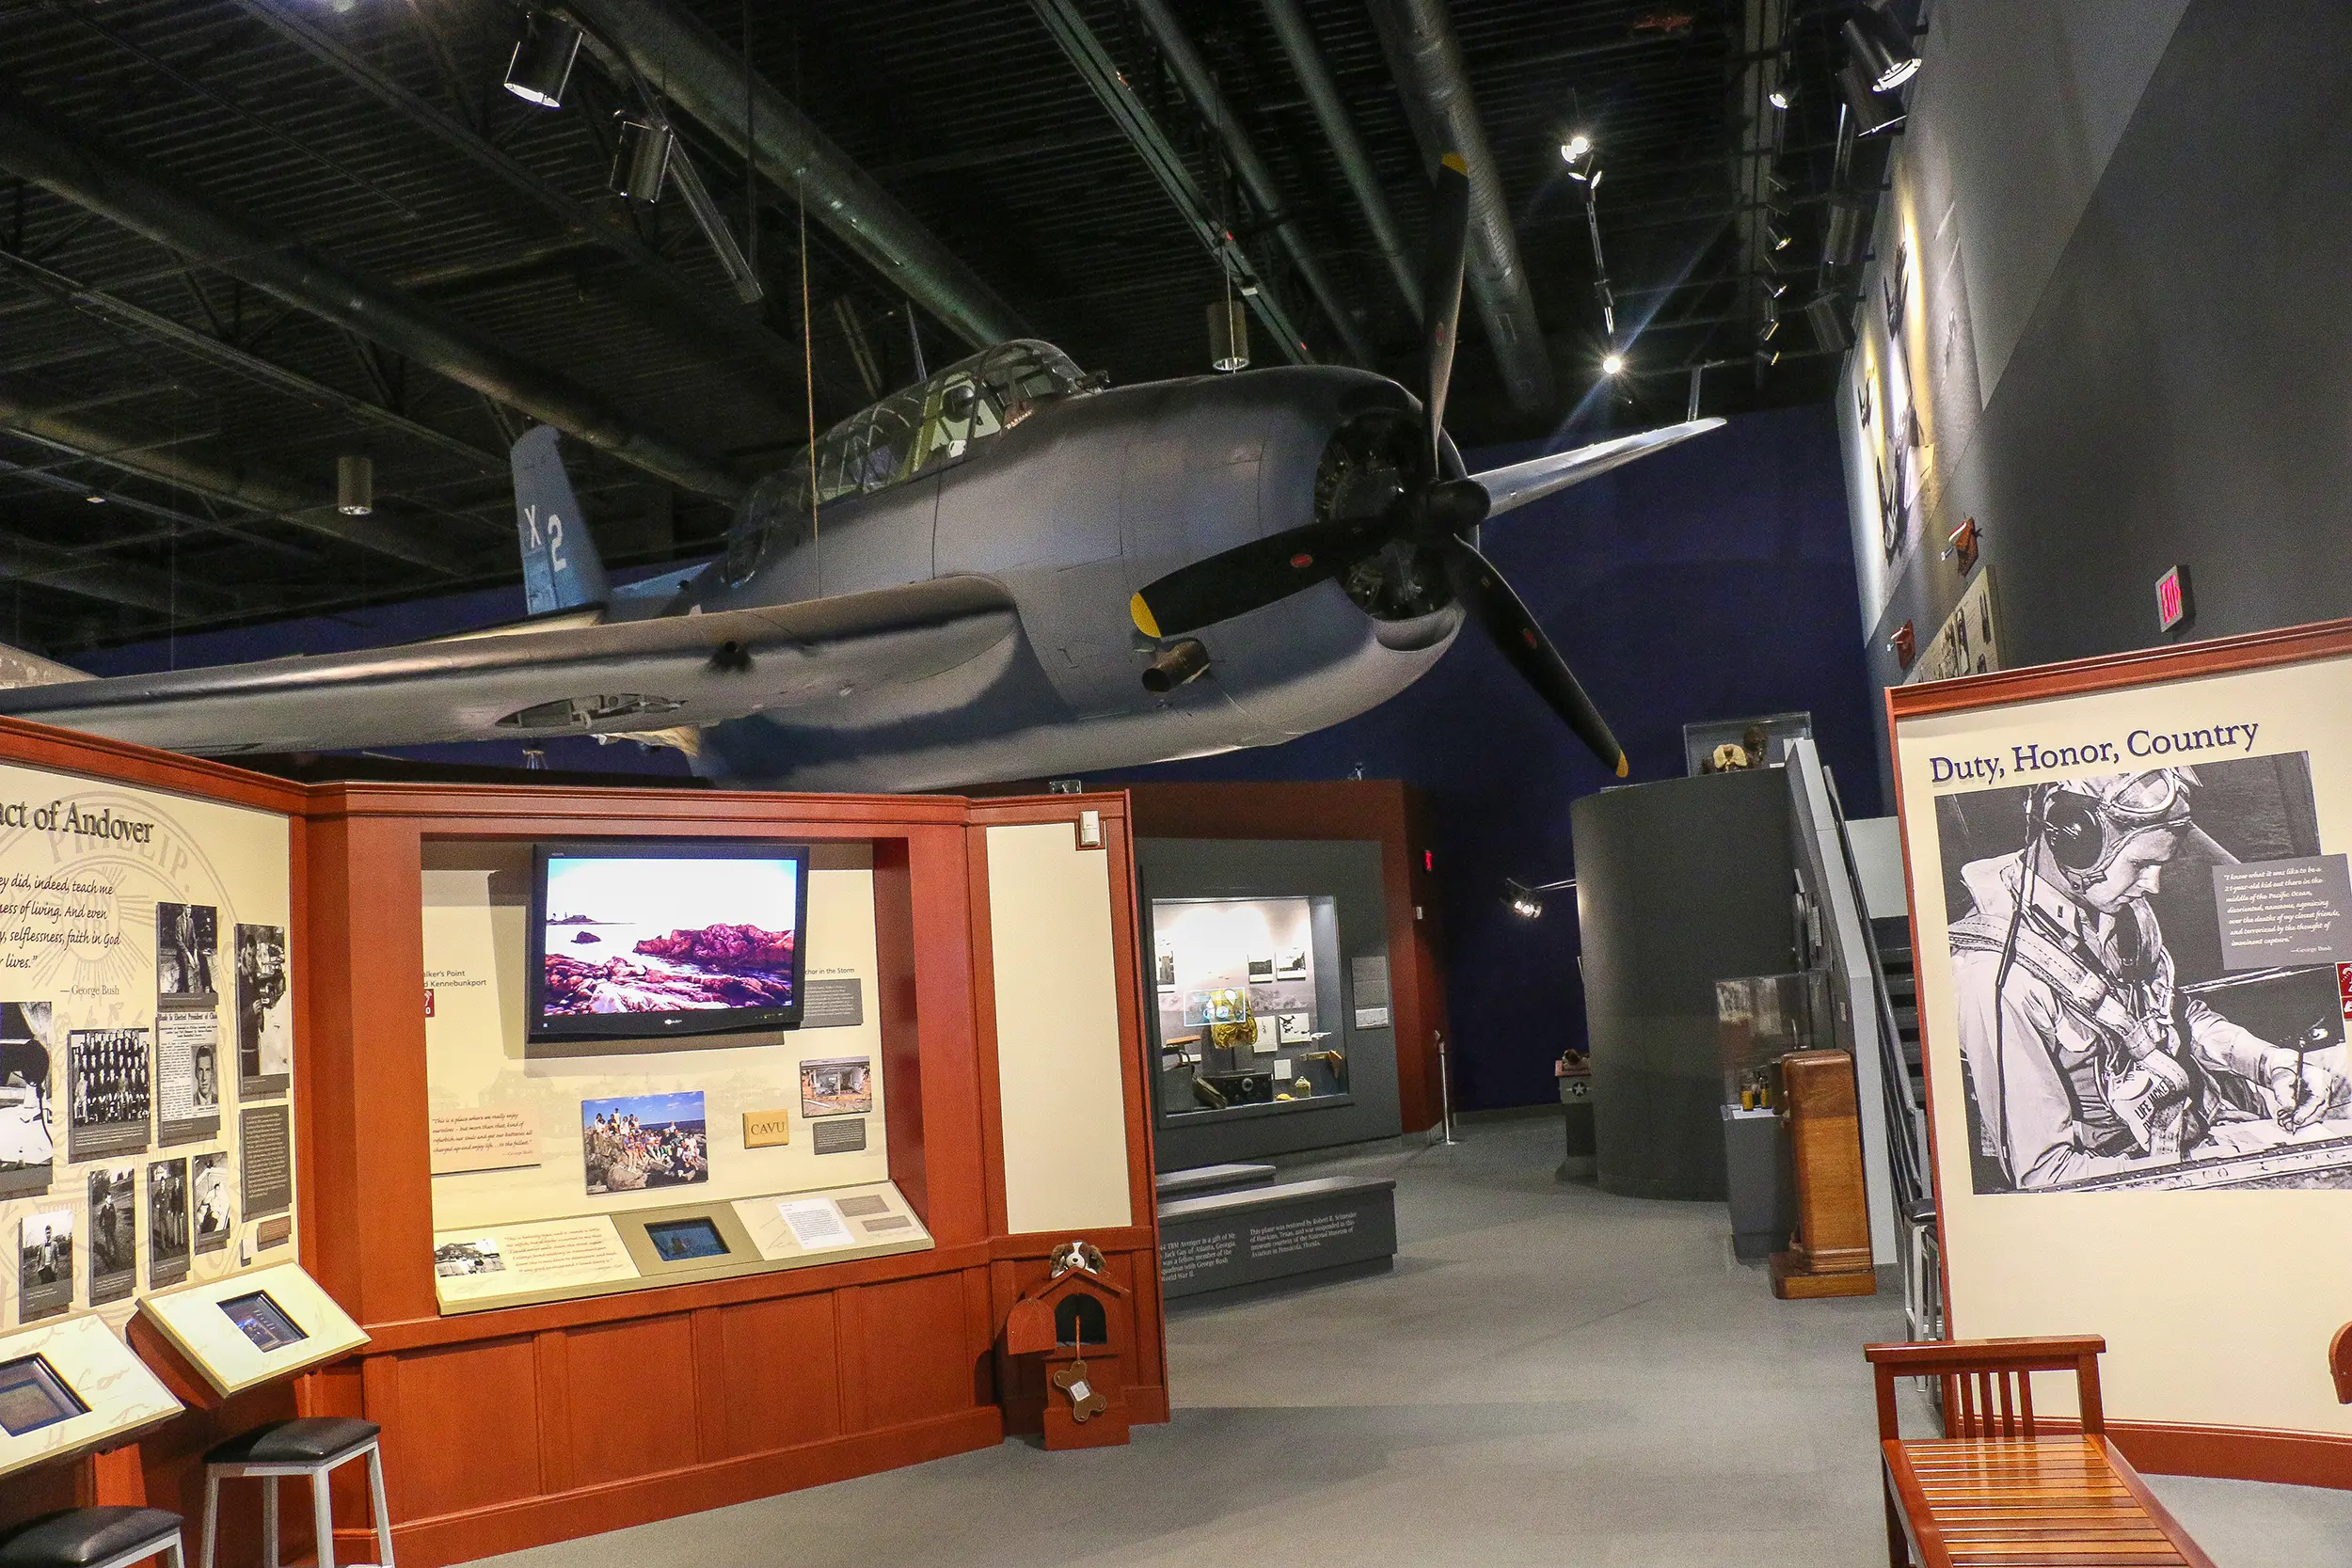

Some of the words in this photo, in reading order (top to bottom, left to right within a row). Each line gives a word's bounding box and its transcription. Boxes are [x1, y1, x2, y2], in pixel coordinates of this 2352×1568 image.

[524, 504, 542, 548] X
[547, 513, 567, 573] 2
[1930, 752, 2006, 784] Duty,
[2011, 741, 2120, 774] Honor,
[2126, 721, 2260, 756] Country
[33, 800, 62, 831] of
[62, 802, 154, 844] Andover
[11, 873, 31, 892] did,
[34, 876, 70, 894] indeed,
[72, 879, 99, 894] teach
[99, 885, 114, 895] me
[2250, 894, 2257, 903] of
[2269, 891, 2289, 900] Pacific
[20, 900, 30, 923] of
[31, 901, 62, 924] living.
[64, 904, 86, 918] And
[87, 910, 108, 920] even
[2255, 914, 2276, 923] deaths
[2277, 913, 2283, 923] of
[9, 927, 64, 949] selflessness,
[64, 928, 89, 951] faith
[92, 936, 101, 945] in
[103, 932, 120, 948] God
[2244, 926, 2276, 934] terrorized
[2277, 926, 2283, 934] by
[2296, 923, 2323, 932] thought
[2324, 922, 2330, 930] of
[72, 985, 100, 998] George
[102, 985, 119, 995] Bush
[2135, 1101, 2152, 1119] LIFE
[2147, 1080, 2169, 1102] JACKE
[750, 1121, 785, 1135] CAVU
